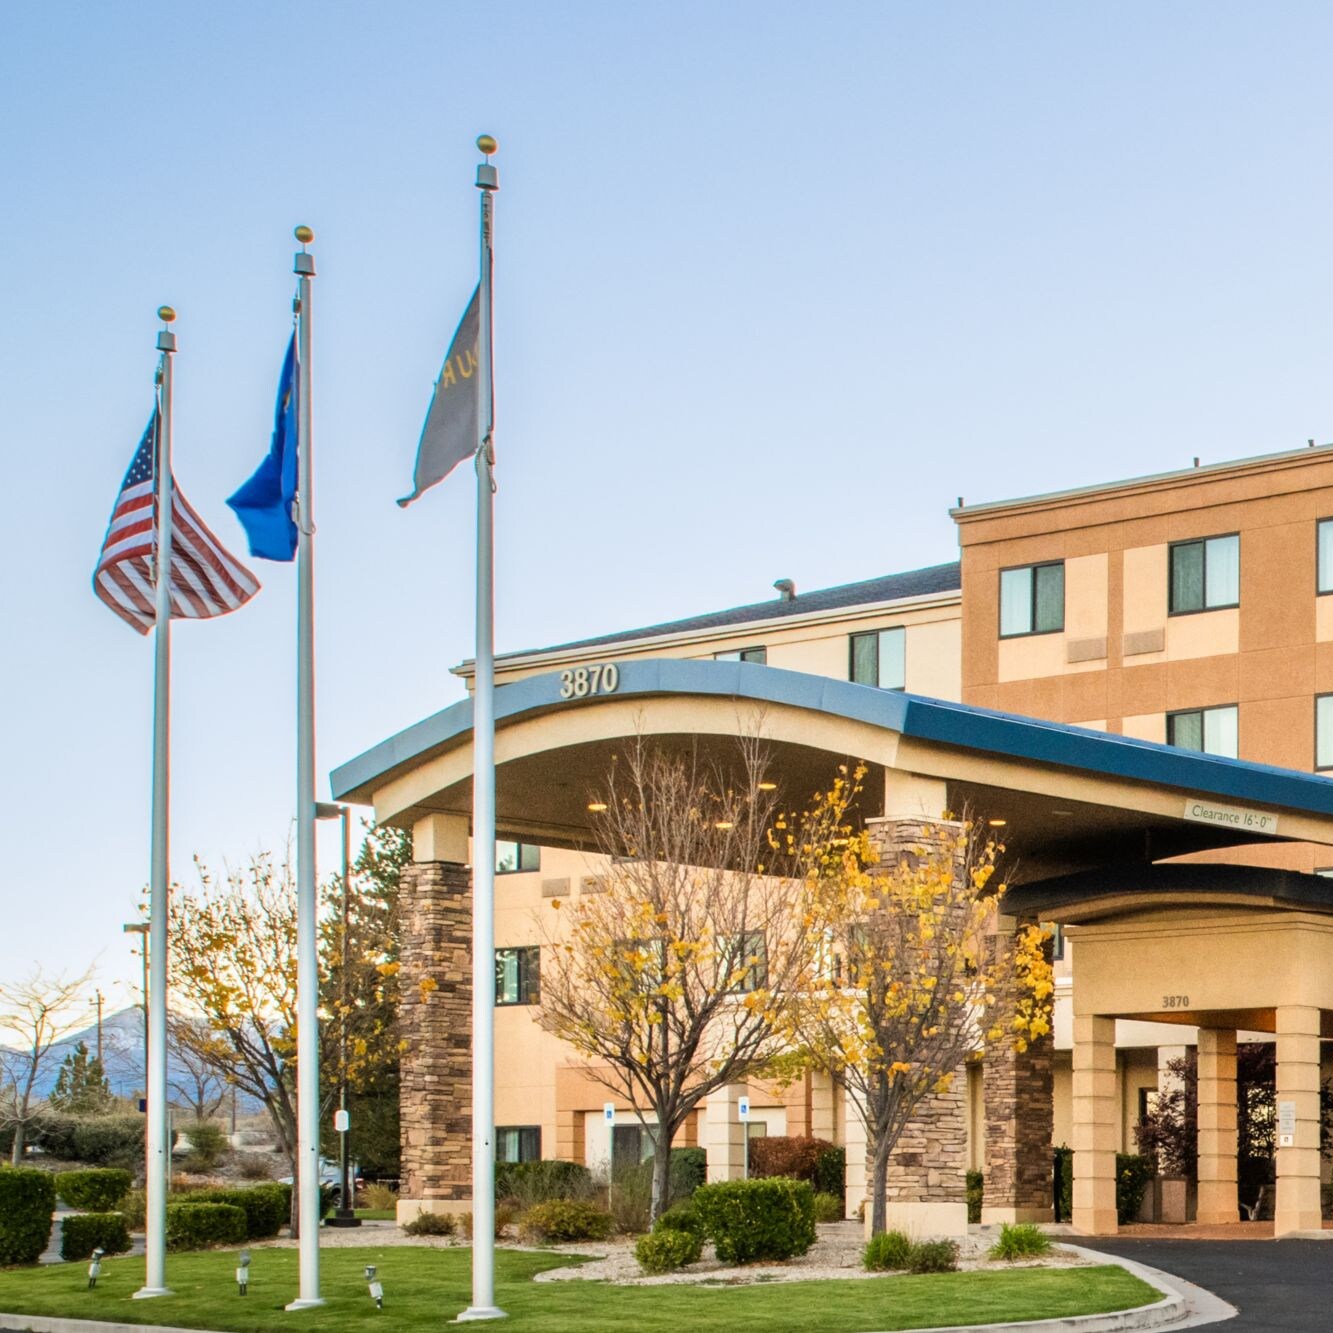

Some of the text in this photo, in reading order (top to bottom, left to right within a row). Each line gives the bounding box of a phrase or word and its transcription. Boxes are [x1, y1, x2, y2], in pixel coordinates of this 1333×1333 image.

[560, 663, 619, 698] 3870
[1191, 804, 1240, 824] Clearance
[1161, 995, 1190, 1009] 3870
